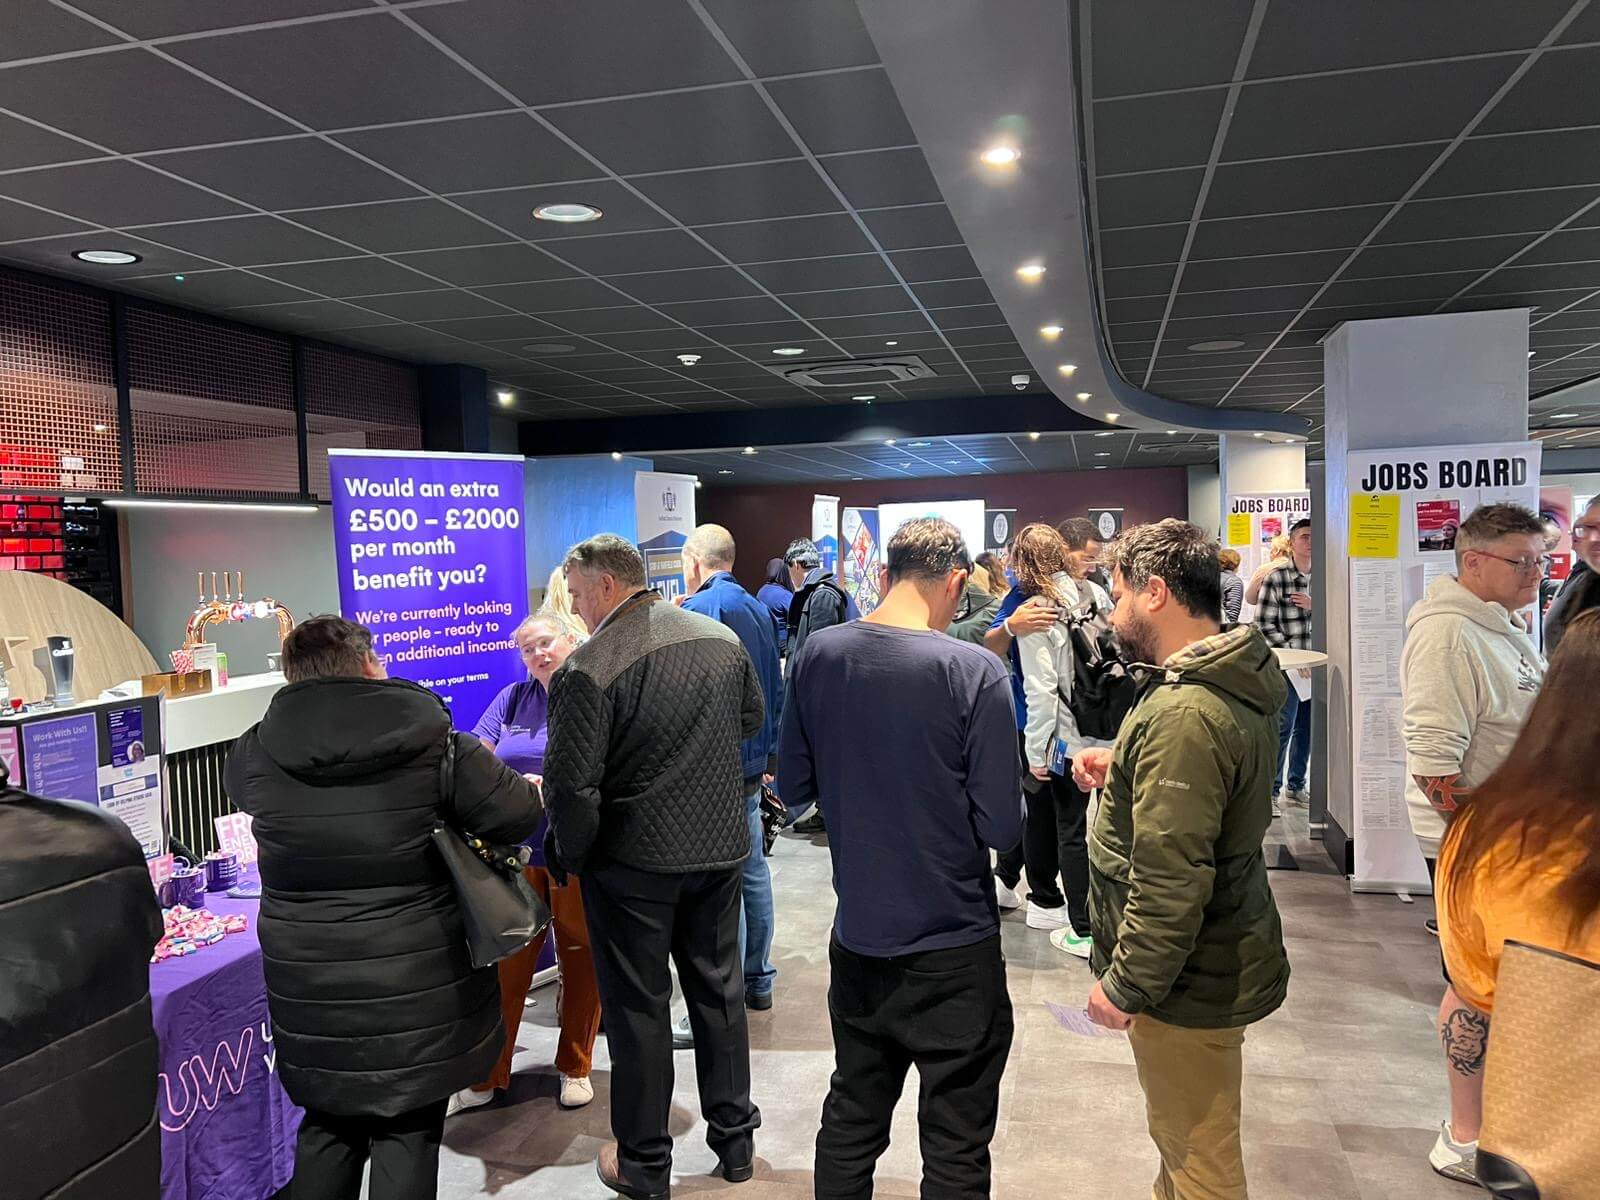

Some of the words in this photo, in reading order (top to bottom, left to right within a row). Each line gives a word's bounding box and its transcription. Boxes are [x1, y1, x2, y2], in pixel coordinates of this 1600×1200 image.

[344, 477, 415, 497] Would
[419, 482, 445, 497] an
[450, 481, 499, 497] extra
[1362, 462, 1429, 491] JOBS
[1439, 458, 1527, 488] BOARD
[1232, 499, 1263, 513] JOBS
[1268, 498, 1309, 512] BOARD
[349, 508, 418, 532] £500
[445, 507, 520, 530] £2000
[350, 541, 387, 563] per
[392, 535, 456, 557] month
[352, 565, 433, 591] benefit
[437, 563, 487, 591] you?
[356, 608, 398, 626] We're
[400, 604, 461, 623] currently
[463, 601, 513, 618] looking
[383, 627, 431, 646] people
[444, 623, 484, 641] ready
[485, 621, 500, 634] to
[396, 641, 465, 662] additional
[435, 678, 447, 687] on
[447, 676, 465, 687] your
[466, 672, 489, 682] terms
[32, 733, 53, 743] Work
[54, 728, 72, 738] With
[157, 1027, 253, 1132] UW
